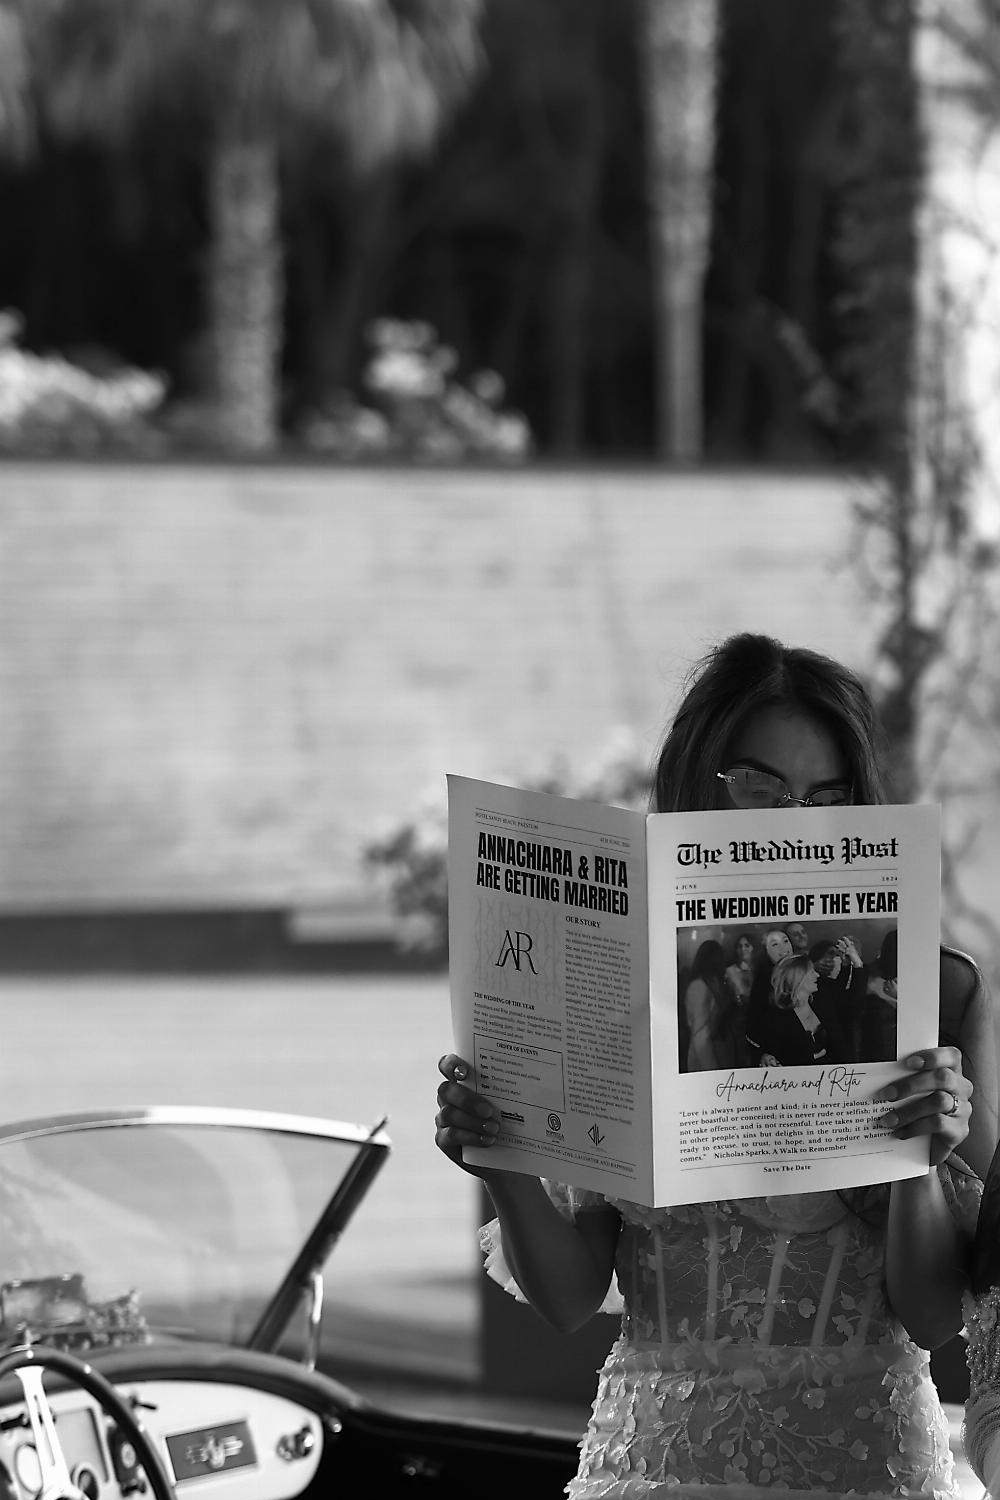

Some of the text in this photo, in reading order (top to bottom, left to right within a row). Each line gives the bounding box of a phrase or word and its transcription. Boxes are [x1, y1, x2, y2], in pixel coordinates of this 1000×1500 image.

[478, 832, 628, 888] ANNACHIARA & RITA
[677, 836, 898, 868] The Wedding Post
[476, 862, 629, 916] ARE GETTING MARRIED
[676, 892, 898, 921] THE WEDDING OF THE YEAR
[565, 916, 601, 928] OUR STORY
[716, 1066, 866, 1102] Annachiara and Rita
[701, 1116, 728, 1124] boastful
[711, 1133, 739, 1142] people's
